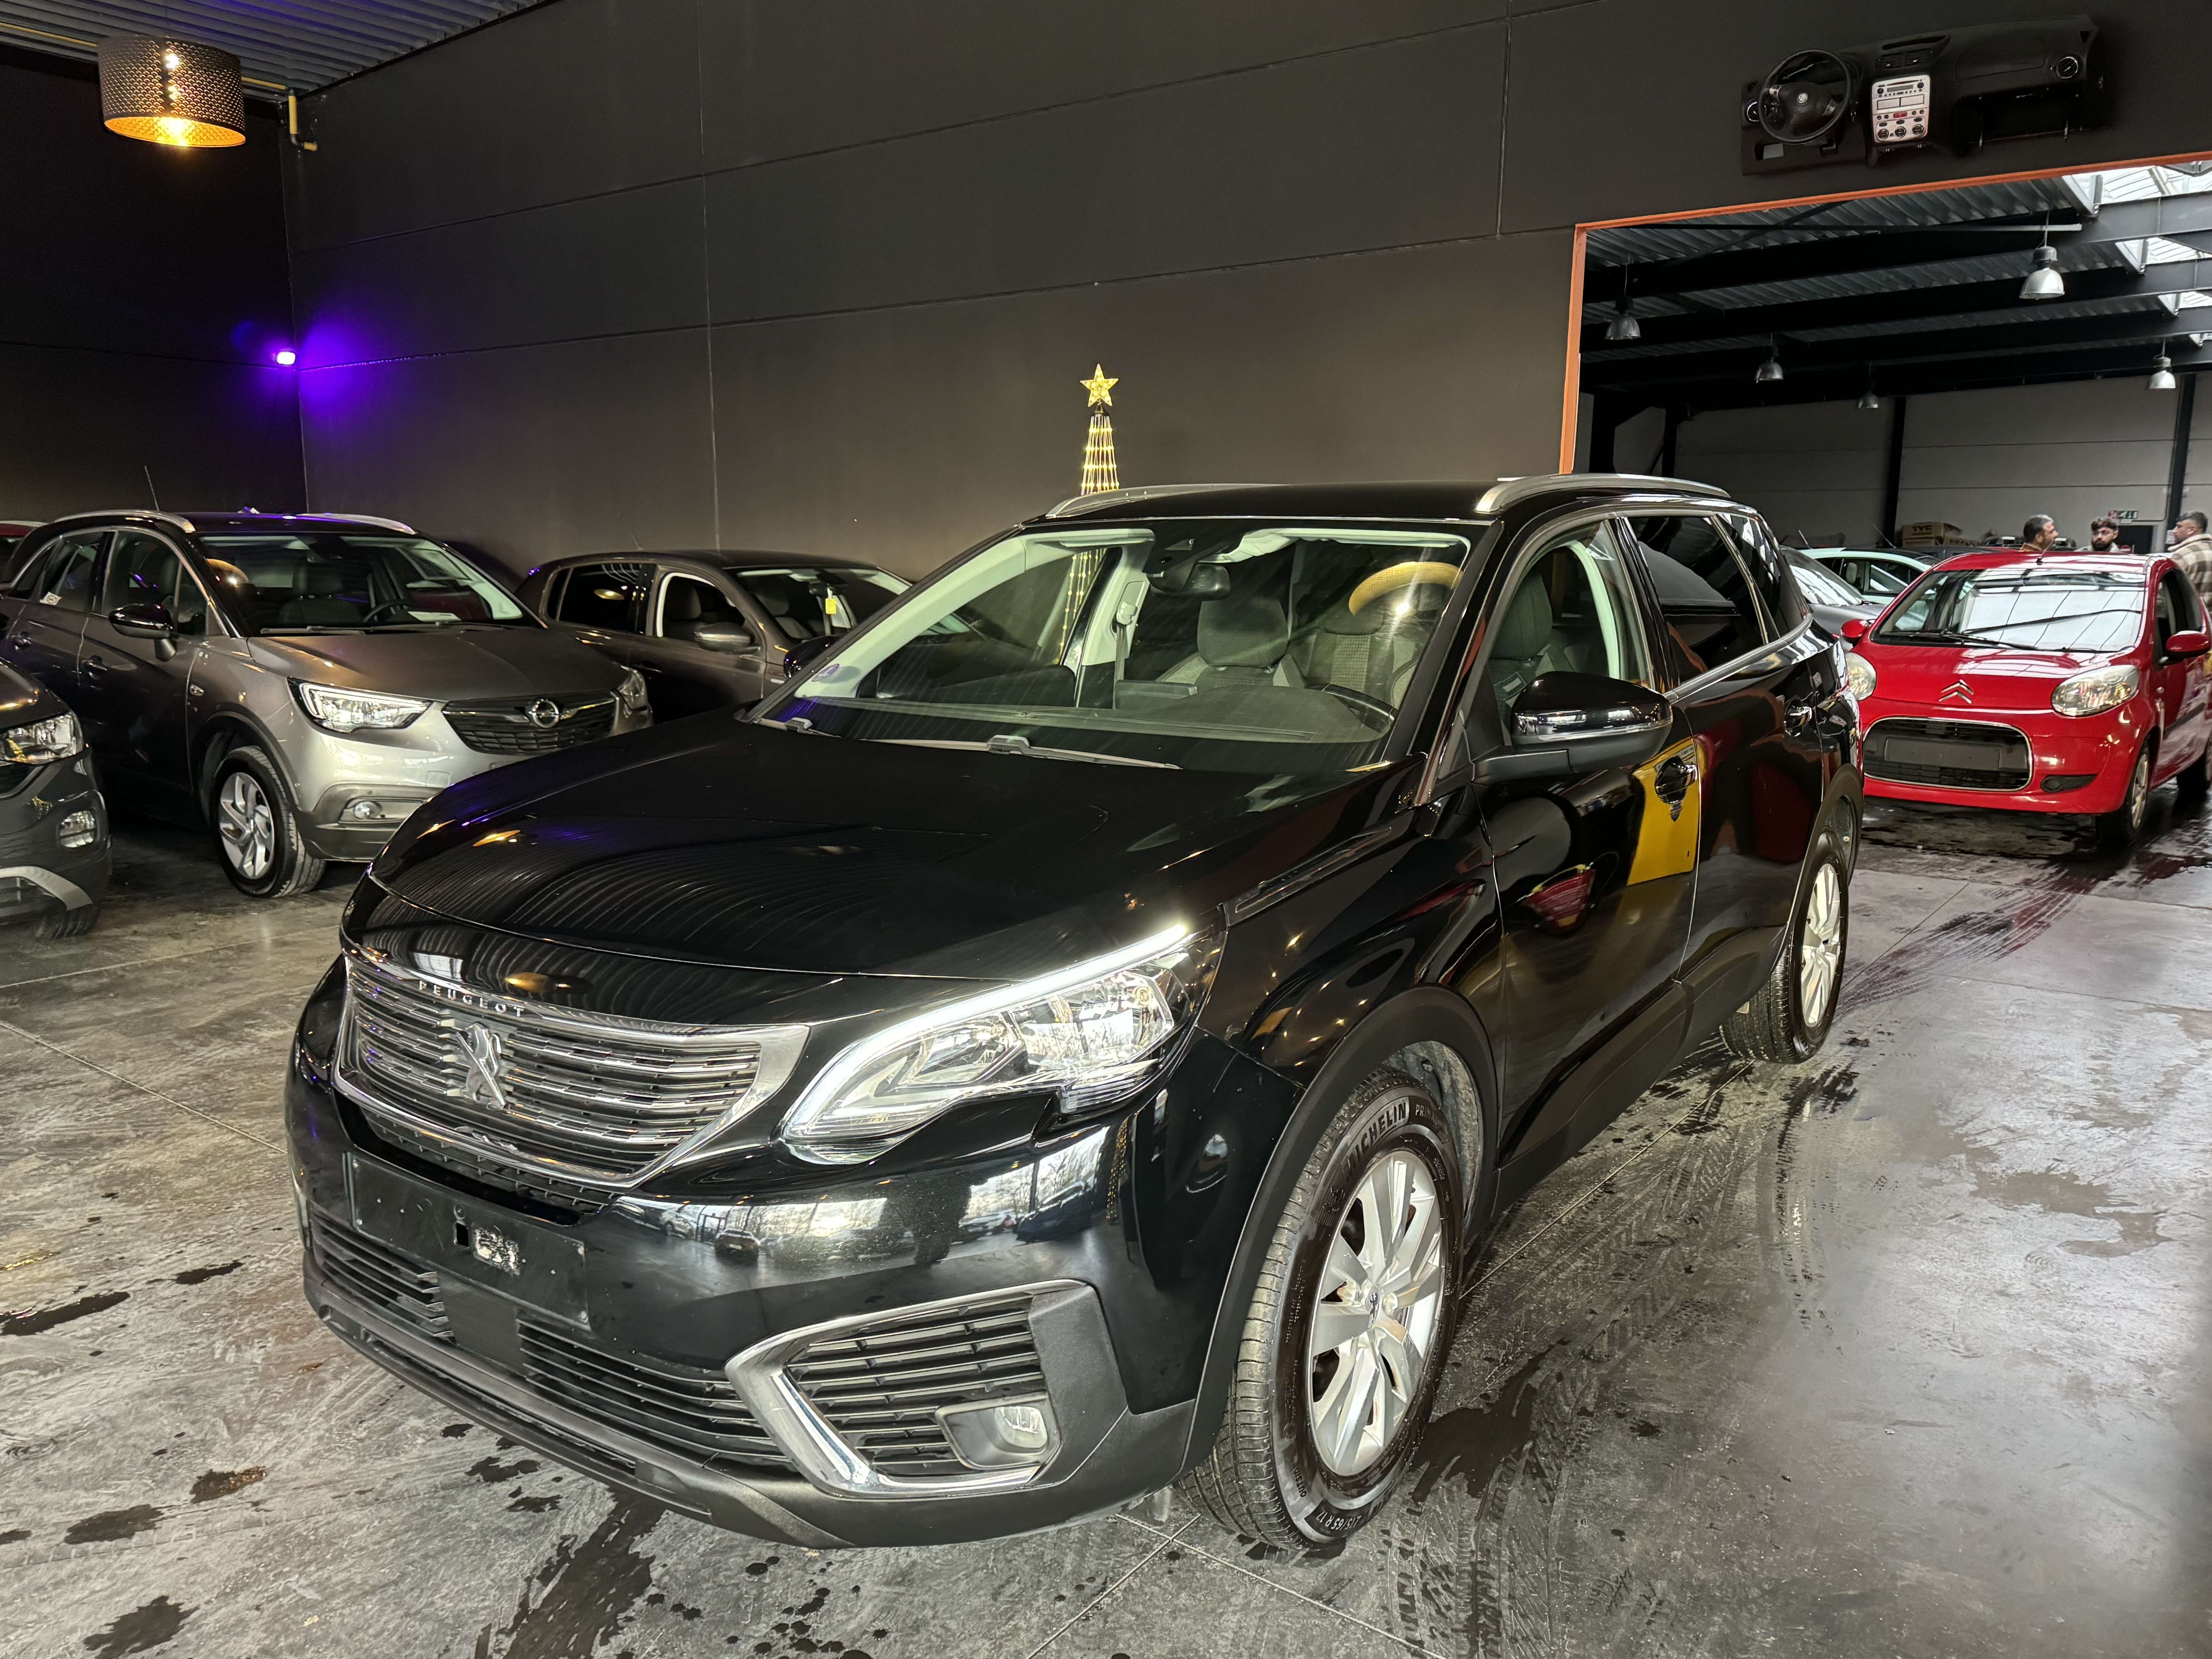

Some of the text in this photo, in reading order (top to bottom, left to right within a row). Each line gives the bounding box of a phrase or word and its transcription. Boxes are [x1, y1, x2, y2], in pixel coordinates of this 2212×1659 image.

[419, 980, 524, 1017] PEUGEOT
[1341, 1102, 1407, 1183] MICHELIN
[1415, 1104, 1441, 1126] PRIMAC
